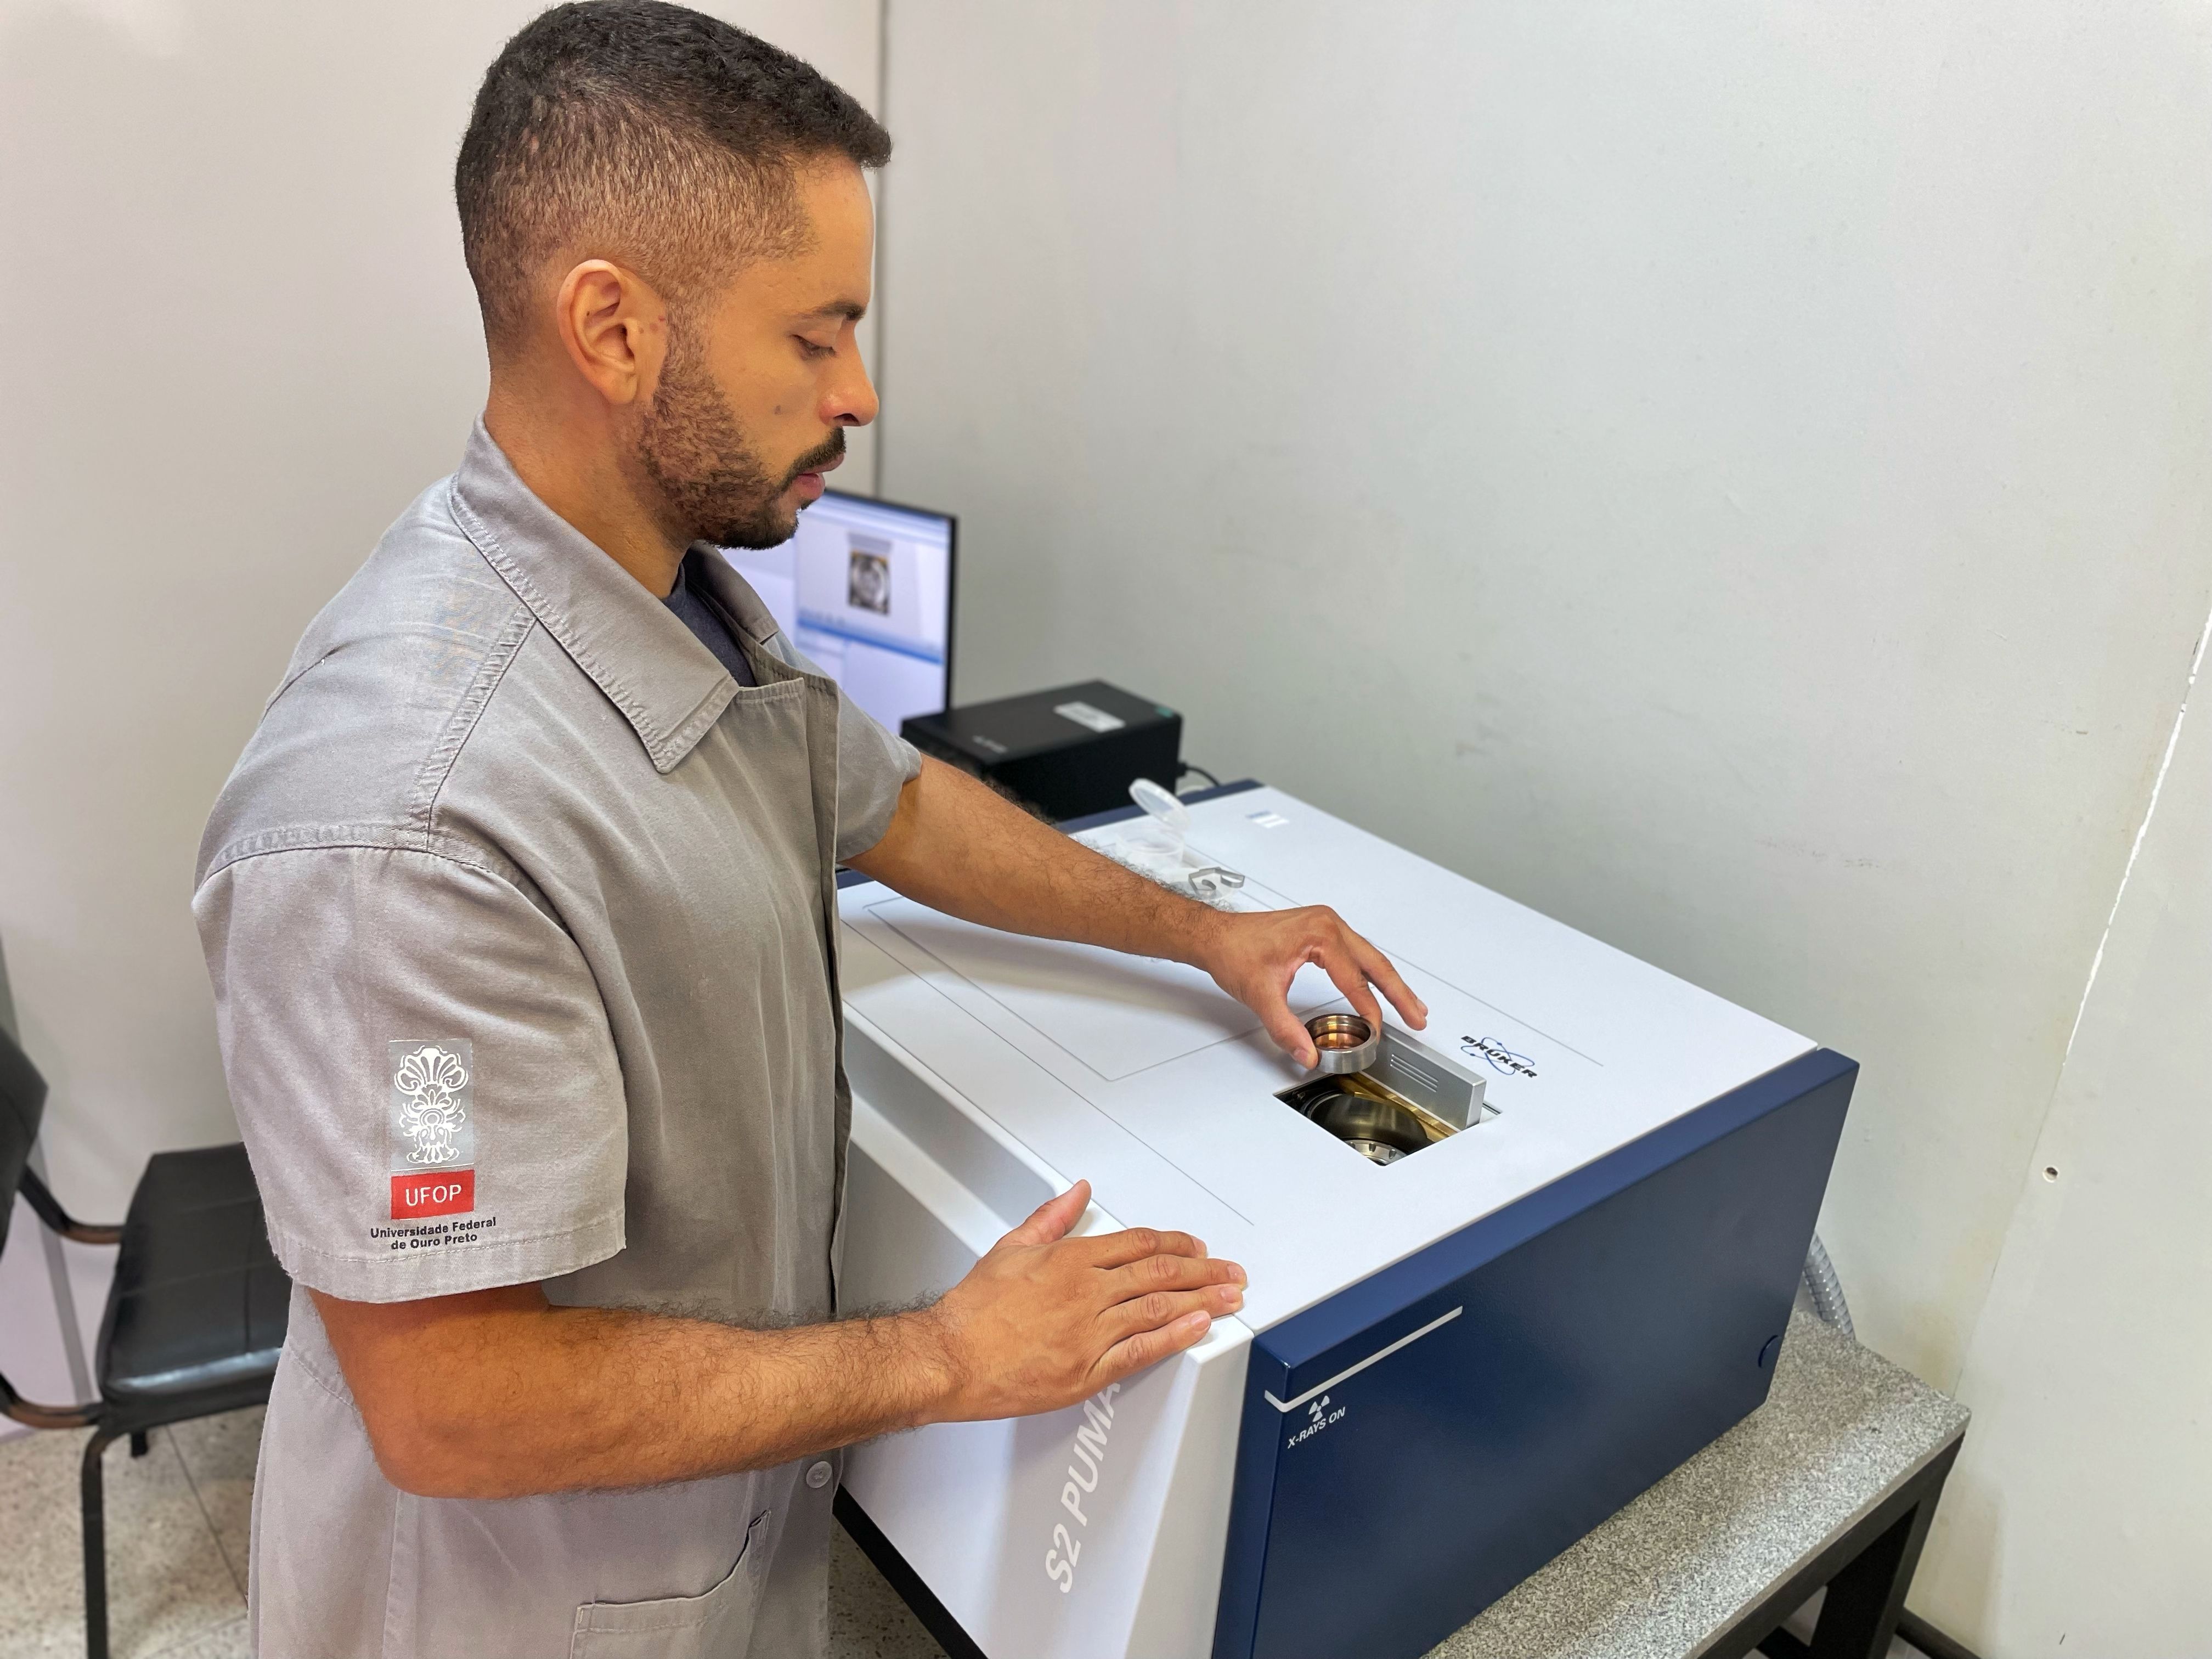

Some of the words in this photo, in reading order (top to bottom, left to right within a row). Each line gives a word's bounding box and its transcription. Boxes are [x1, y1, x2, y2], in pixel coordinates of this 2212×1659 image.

[1461, 1036, 1537, 1078] BRUKER
[405, 1184, 461, 1206] UFOP
[370, 1224, 449, 1238] Universidade
[453, 1217, 496, 1232] Federal
[391, 1240, 407, 1250] de
[410, 1238, 440, 1249] Ouro
[445, 1233, 477, 1245] Preto
[1288, 1418, 1326, 1449] X-RAYS
[1329, 1407, 1346, 1423] ON
[1046, 1523, 1081, 1593] S2
